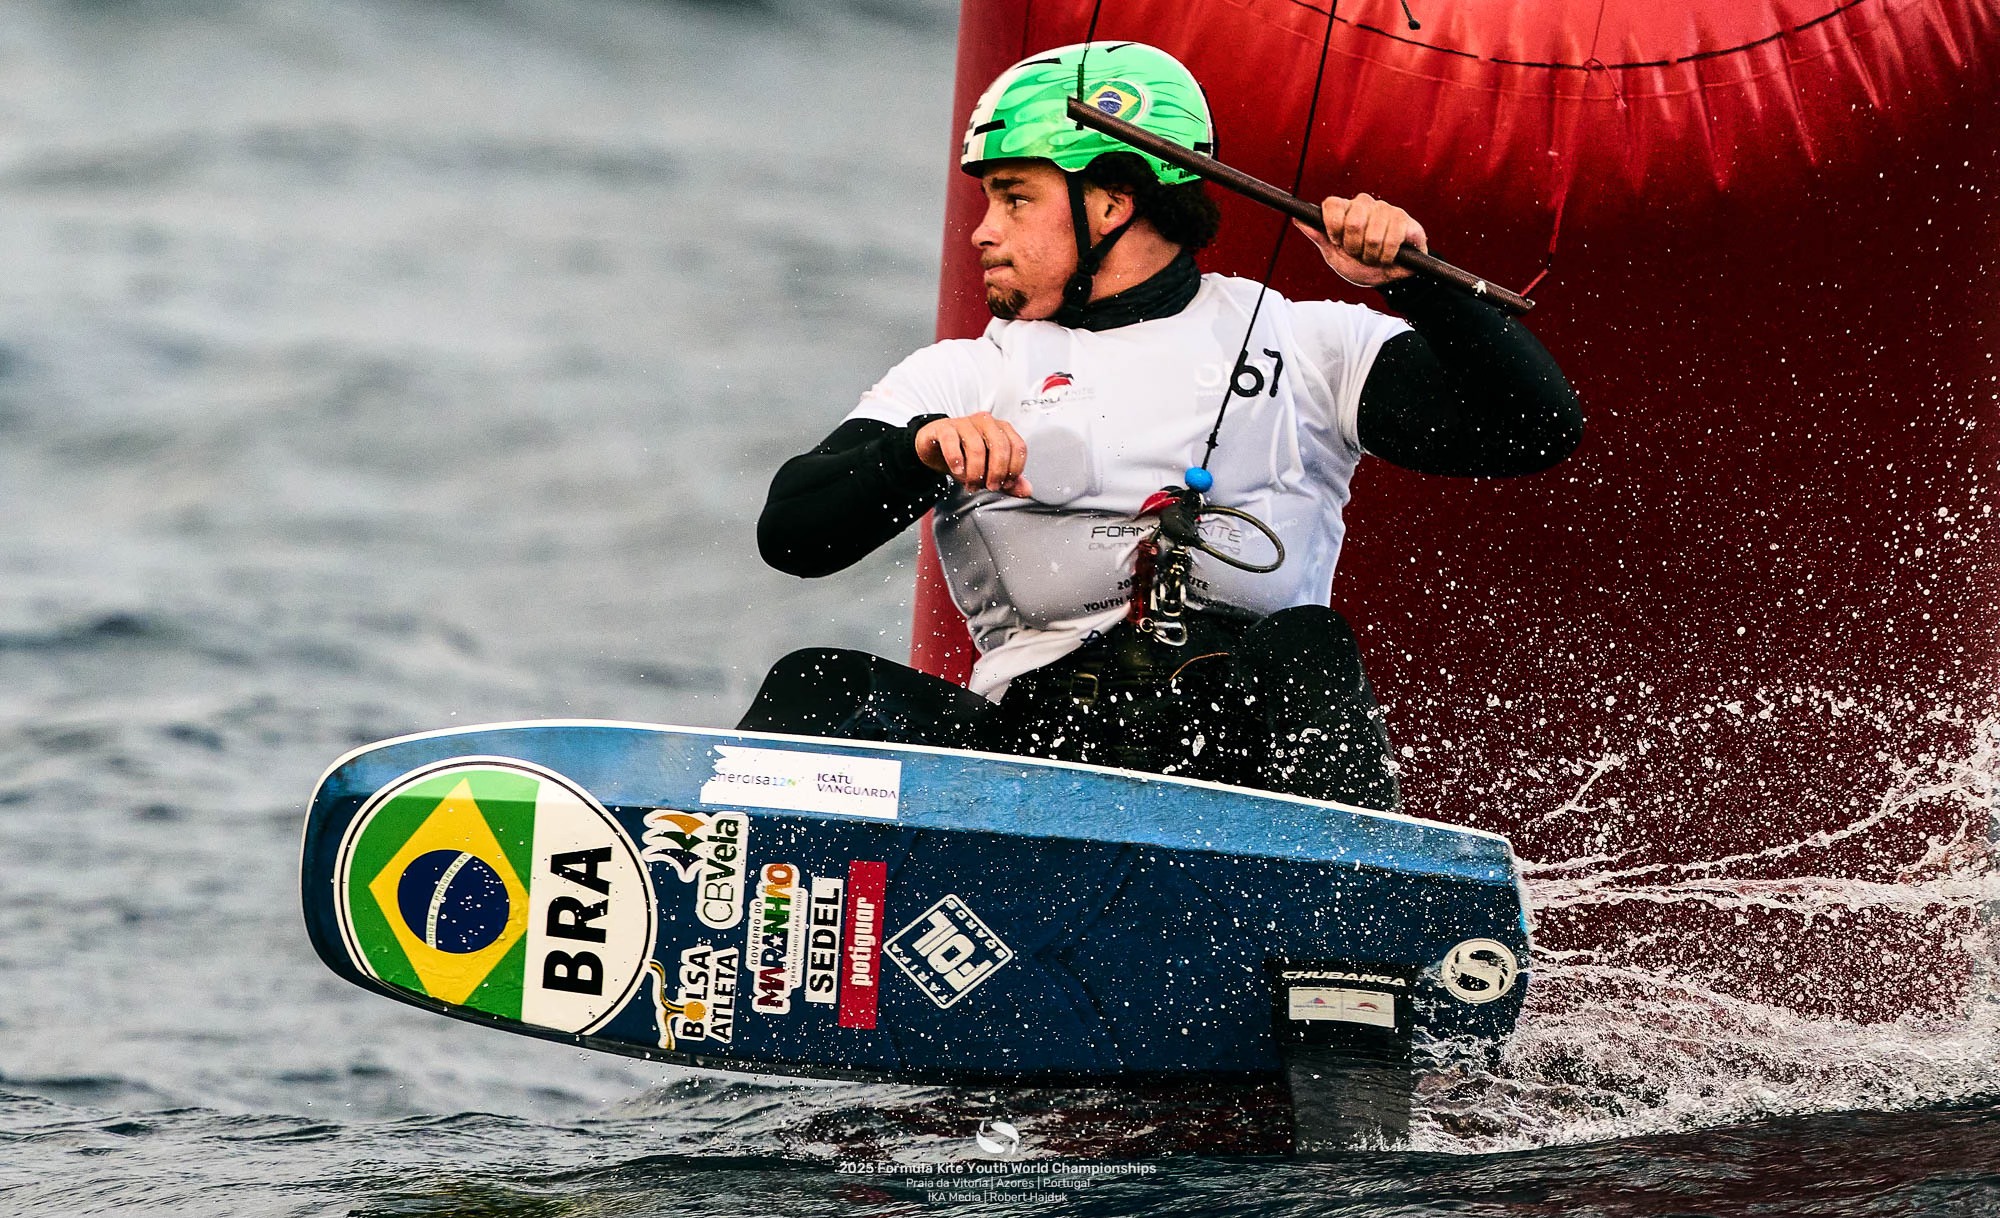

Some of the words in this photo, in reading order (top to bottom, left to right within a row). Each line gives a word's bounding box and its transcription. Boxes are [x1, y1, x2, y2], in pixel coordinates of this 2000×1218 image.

[1231, 348, 1283, 397] 67
[1083, 597, 1124, 613] YOUTH
[817, 773, 853, 784] ICATU
[817, 783, 897, 799] VANGUARDA
[702, 818, 740, 923] CBVela
[542, 846, 613, 996] BRA
[755, 901, 763, 914] DO
[945, 898, 1007, 960] BOARDS
[751, 919, 762, 965] GOVERNO
[809, 888, 840, 994] SEDEL
[848, 897, 877, 987] potiguar
[911, 910, 994, 992] FOIL
[711, 953, 738, 1040] ATLETA
[891, 943, 950, 1004] TARIFA
[1281, 970, 1407, 987] CHUBANGA
